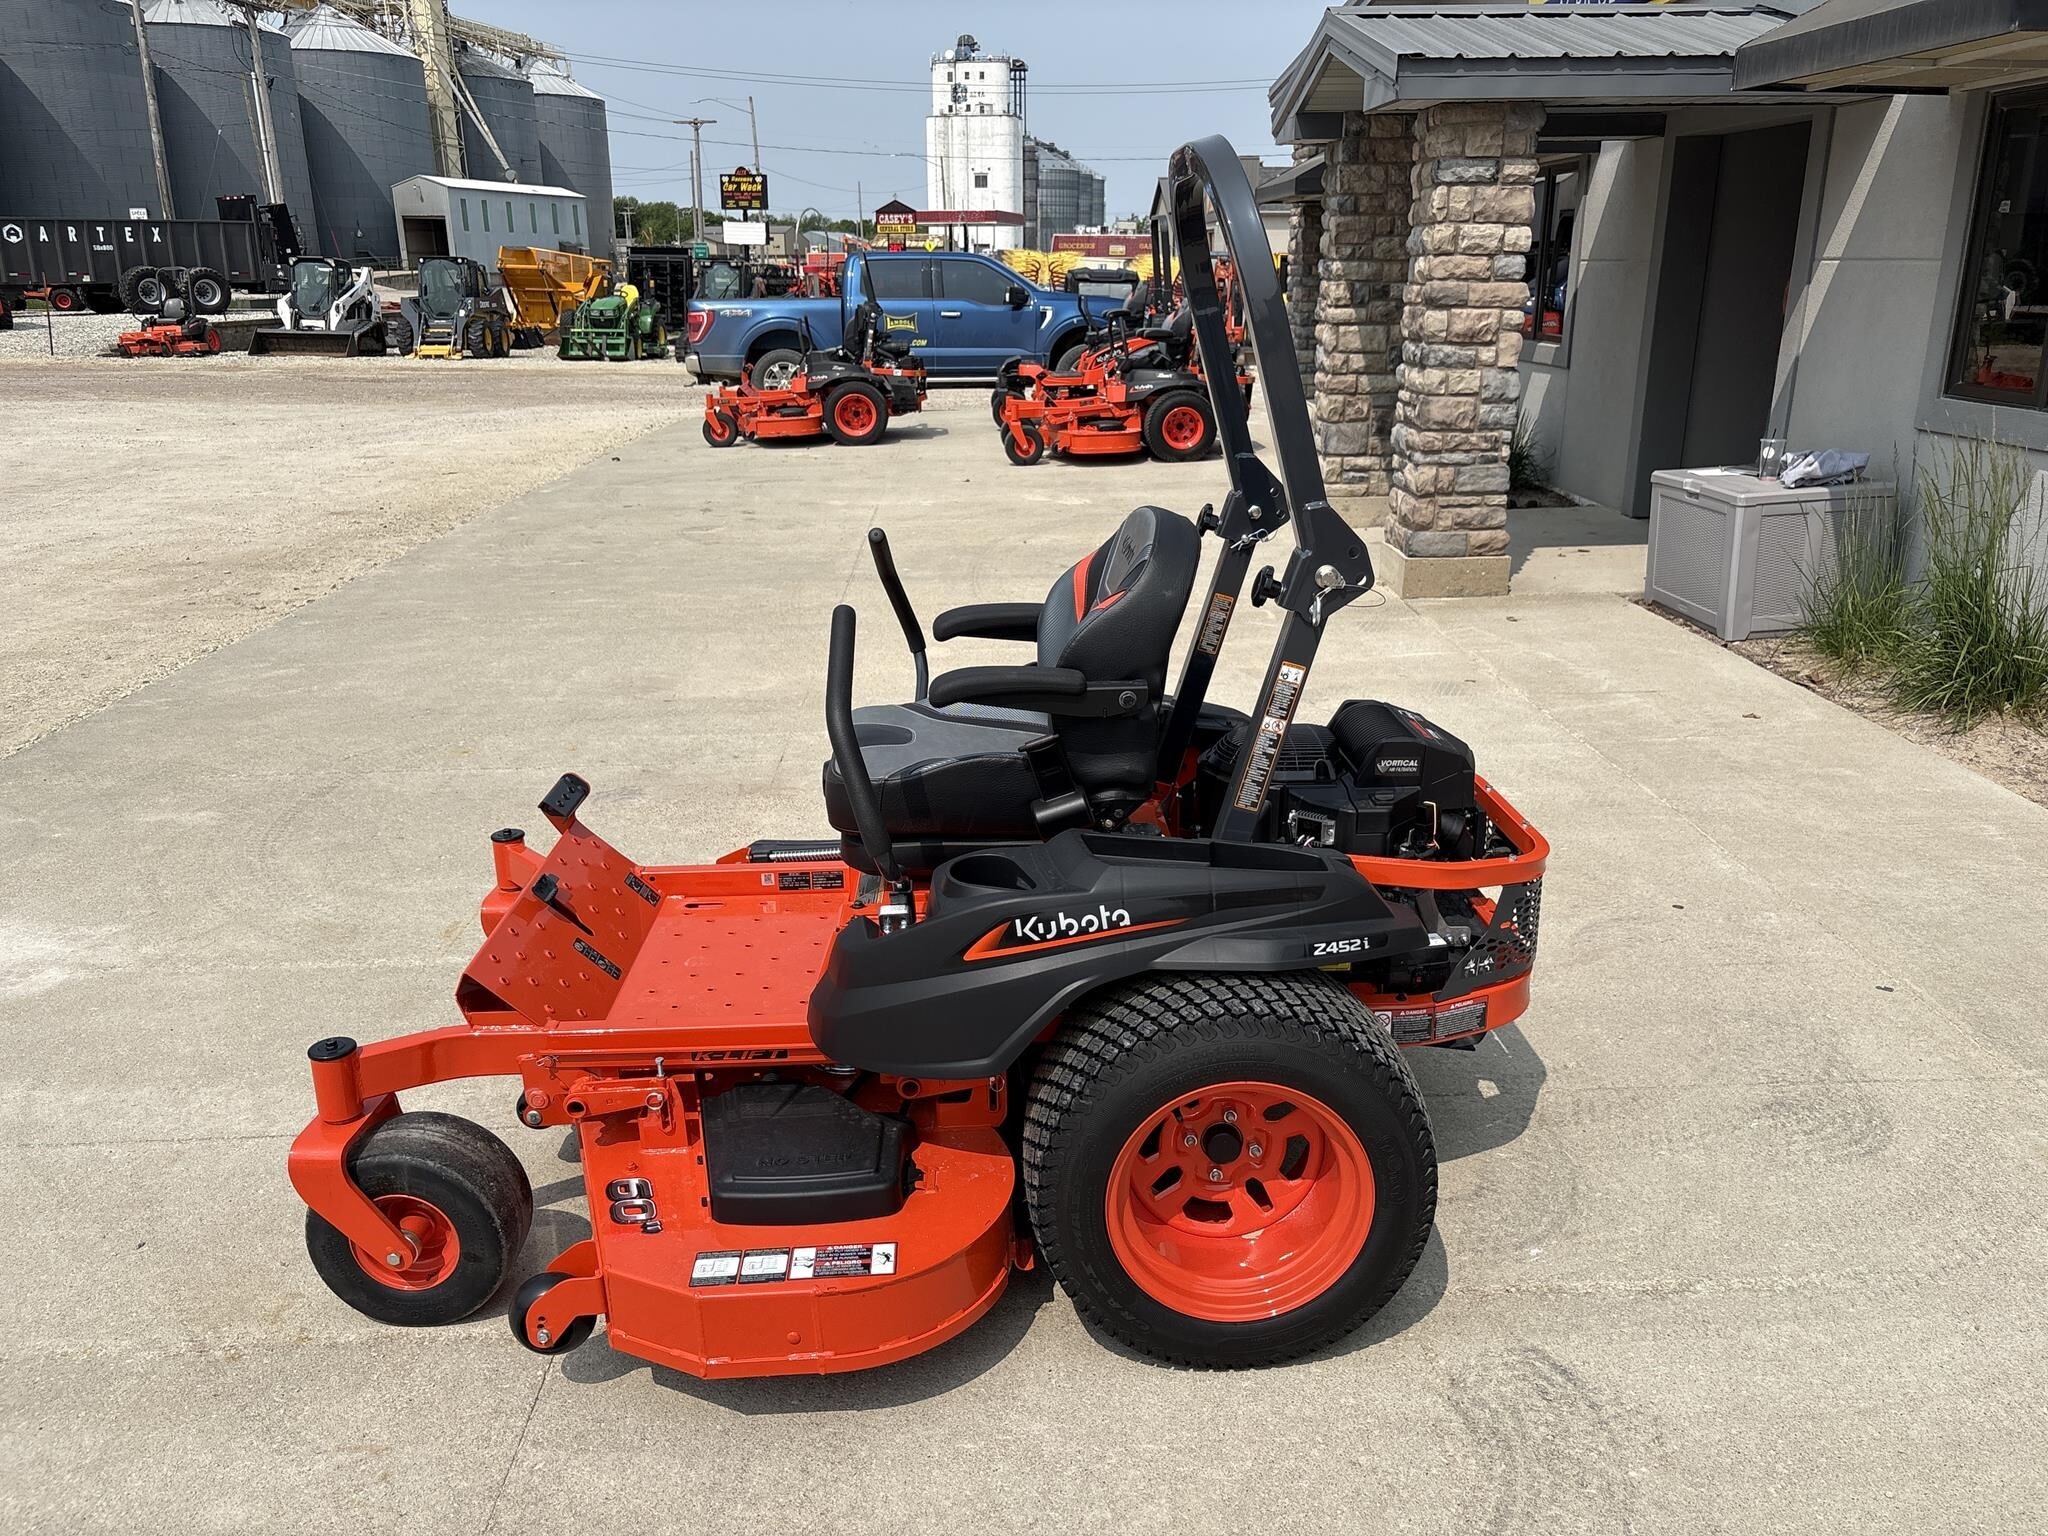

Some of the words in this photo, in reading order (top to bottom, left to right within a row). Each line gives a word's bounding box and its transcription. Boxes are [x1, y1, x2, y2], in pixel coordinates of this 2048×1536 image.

[723, 183, 737, 191] Car
[740, 182, 762, 191] Wash
[879, 214, 914, 224] CASEY'S
[1015, 904, 1131, 942] Kubota
[694, 1049, 785, 1061] K-LIFT
